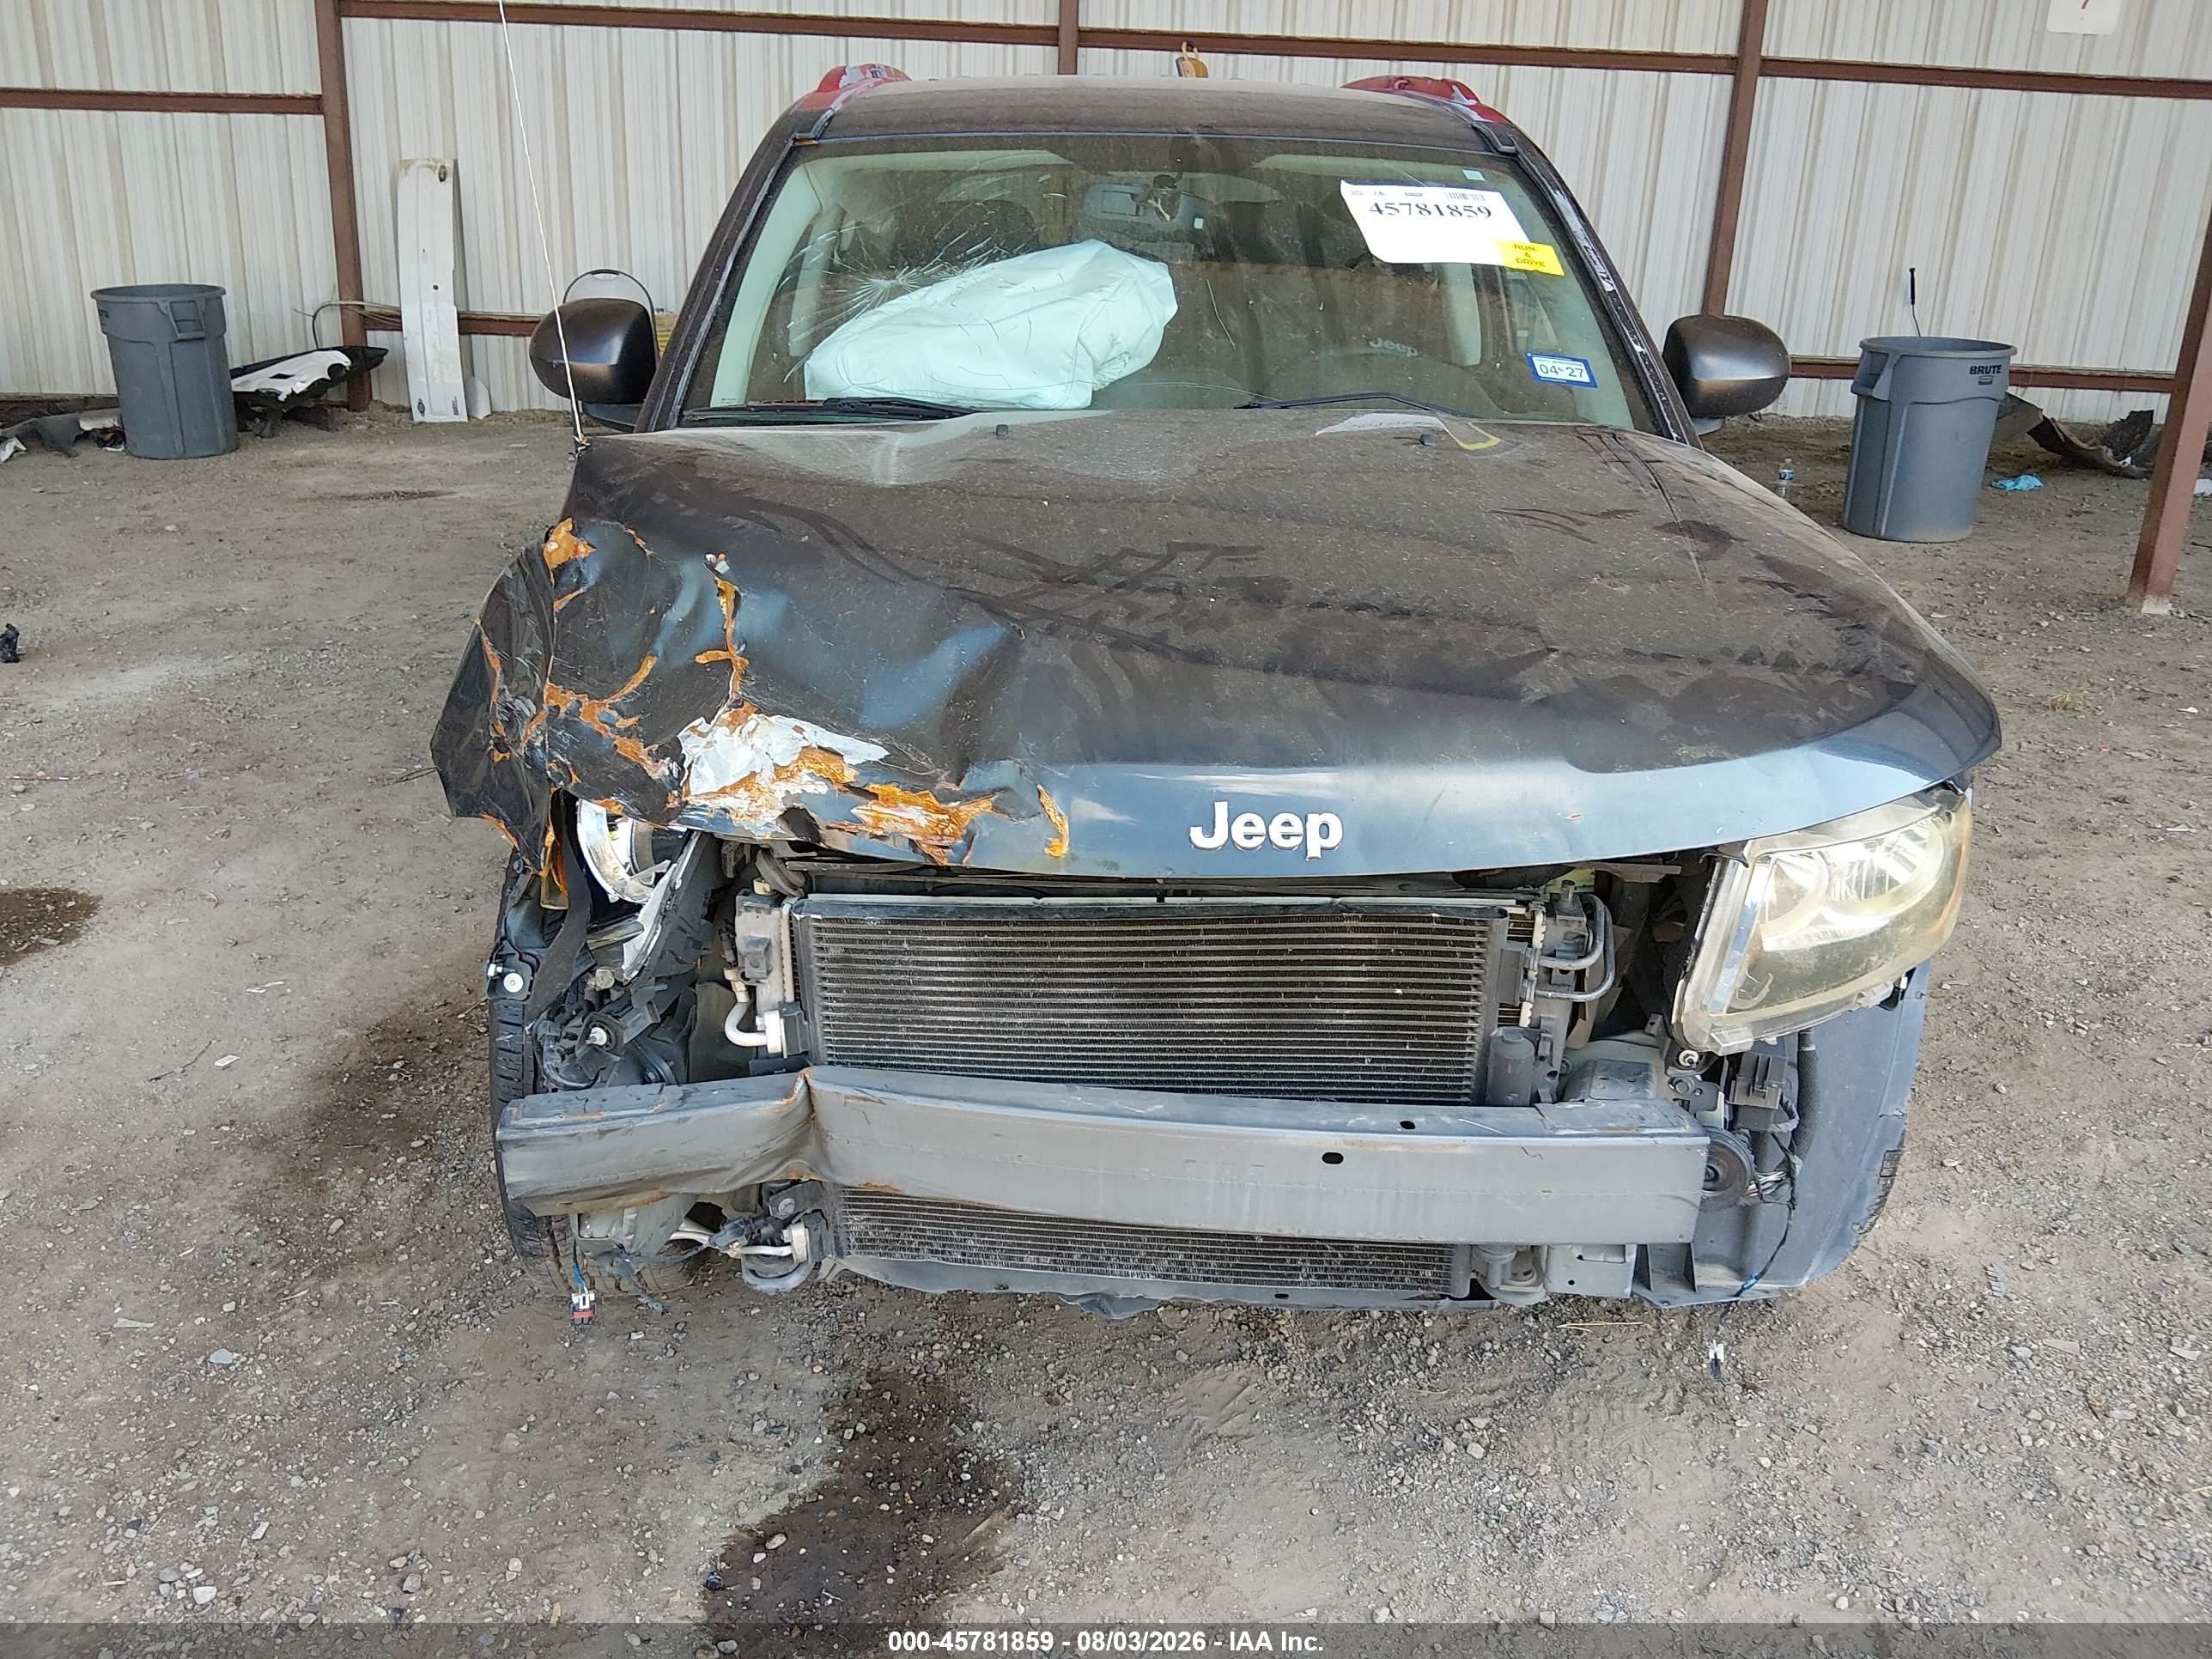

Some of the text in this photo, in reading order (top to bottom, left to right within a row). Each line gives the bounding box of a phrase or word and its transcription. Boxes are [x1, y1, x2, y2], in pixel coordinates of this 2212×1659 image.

[1370, 202, 1492, 218] 45781859
[1516, 258, 1547, 267] DRIVE
[1369, 337, 1419, 357] Jeep
[1969, 364, 2002, 375] BRUTE
[1188, 800, 1344, 861] Jeep
